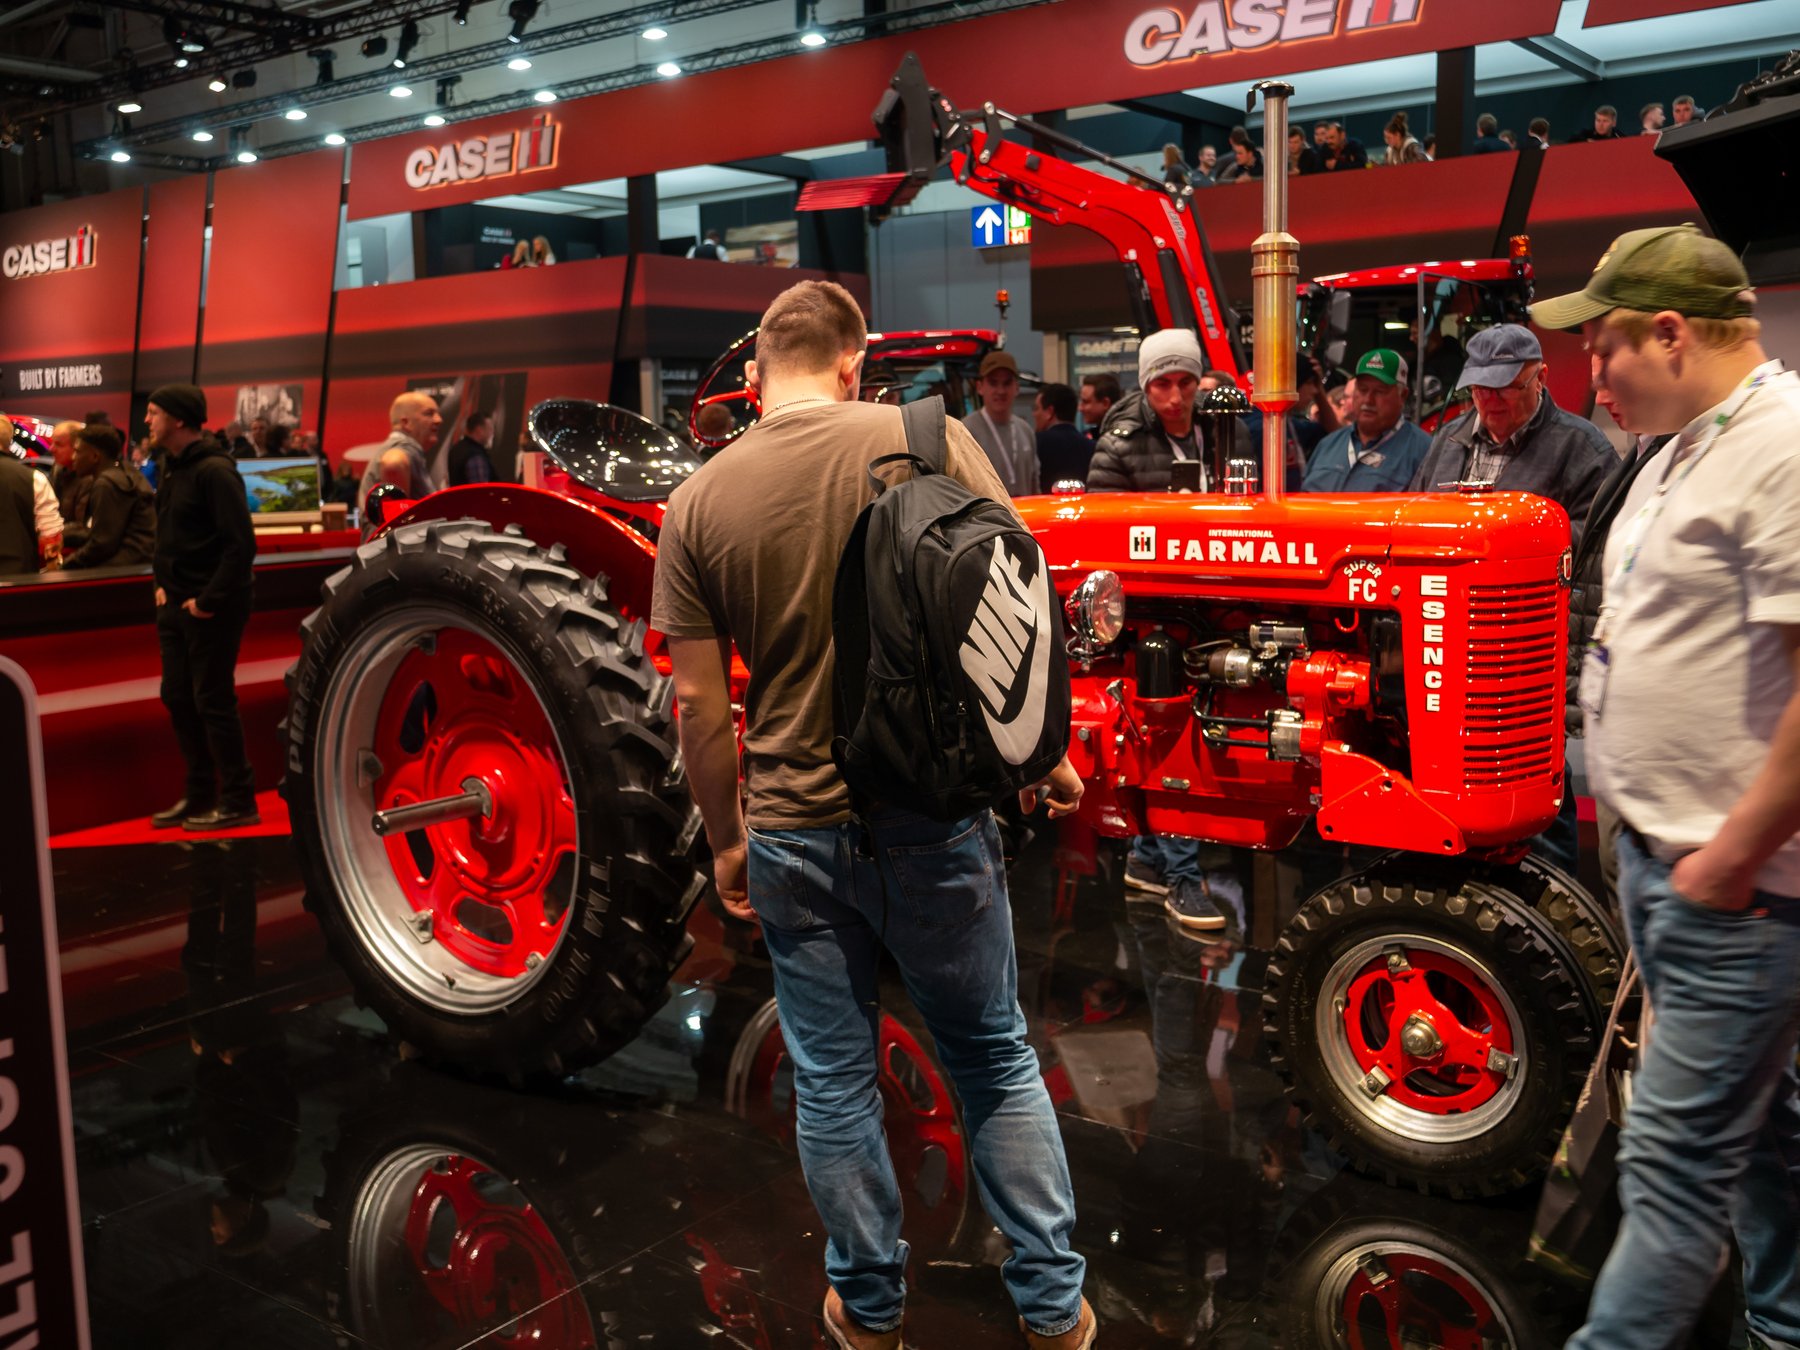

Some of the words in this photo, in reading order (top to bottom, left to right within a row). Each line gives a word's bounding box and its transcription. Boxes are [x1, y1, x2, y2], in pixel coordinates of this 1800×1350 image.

[1124, 0, 1338, 66] CASE
[405, 132, 517, 189] CASE
[3, 239, 69, 278] CASE
[1197, 286, 1215, 327] CASE
[19, 368, 43, 391] BUILT
[45, 367, 57, 390] BY
[59, 363, 103, 388] FARMERS
[1166, 539, 1319, 565] FARMALL
[1208, 528, 1274, 540] INTERNATIONAL
[1343, 560, 1382, 579] SUPER
[1348, 578, 1377, 602] FC
[959, 535, 1039, 716] NIKE
[1420, 574, 1448, 712] ESENCE
